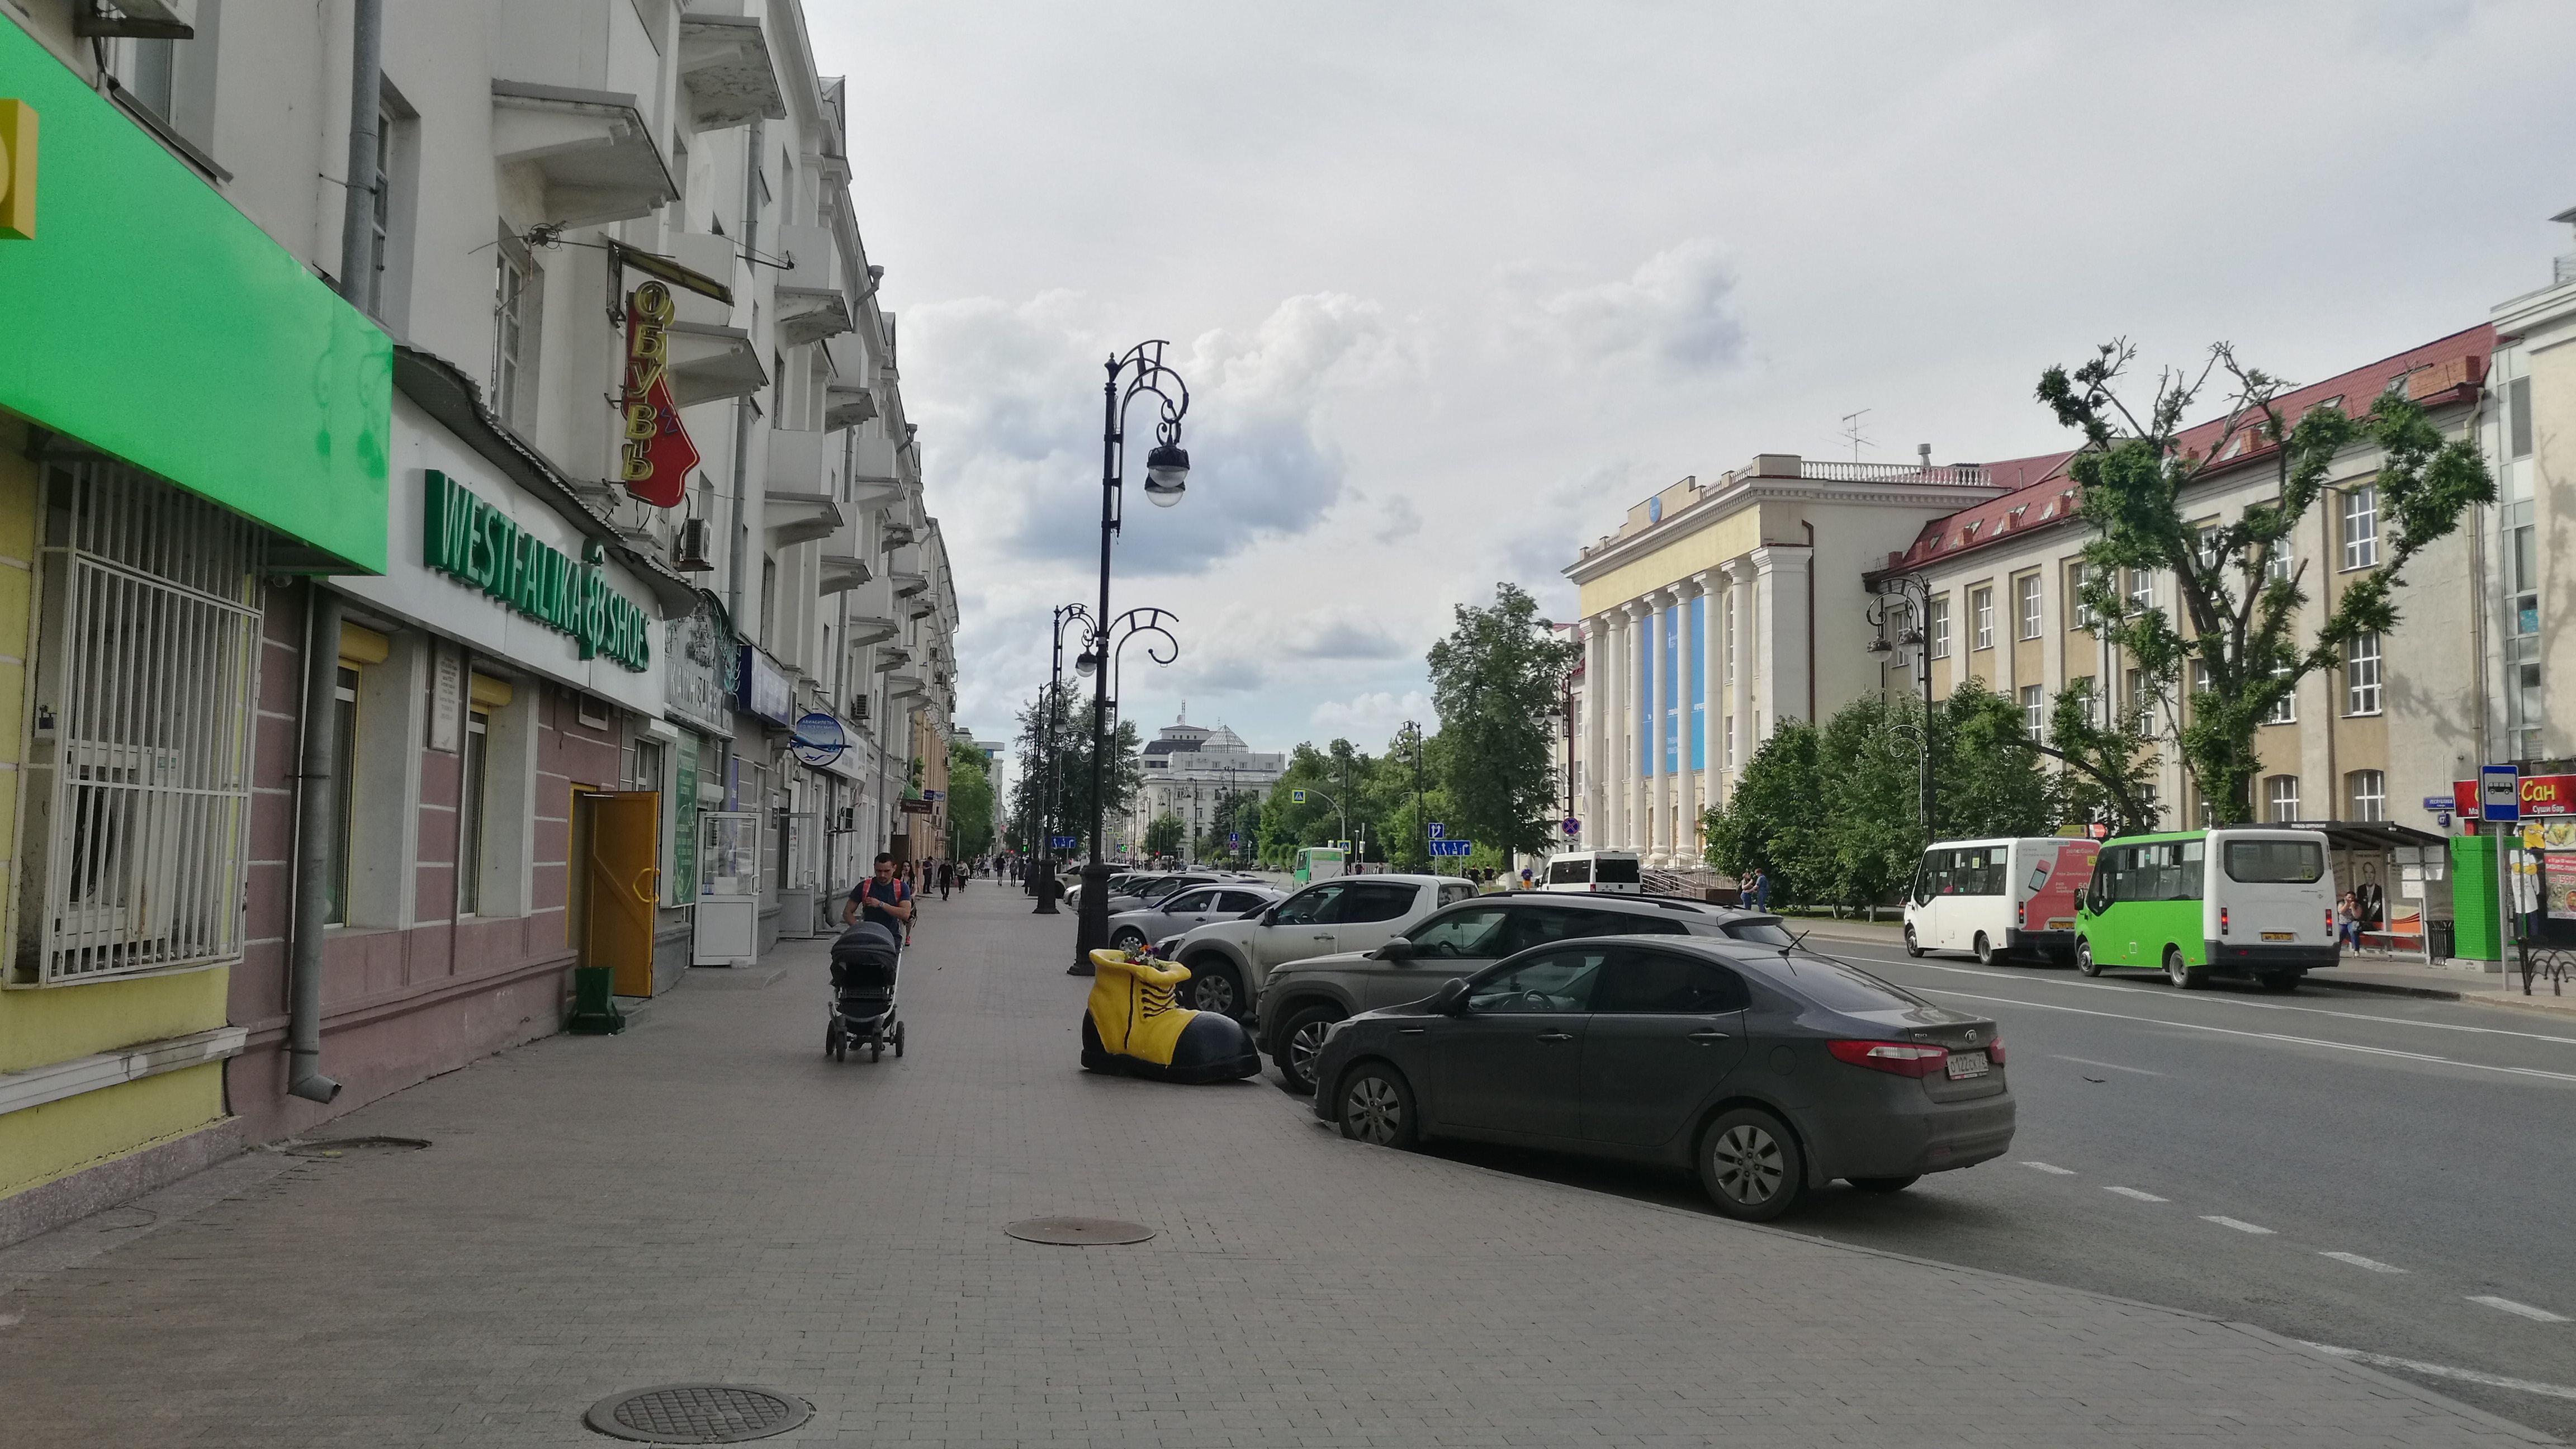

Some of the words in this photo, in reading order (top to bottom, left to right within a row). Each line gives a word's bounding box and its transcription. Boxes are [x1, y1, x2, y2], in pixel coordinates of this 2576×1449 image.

[621, 281, 671, 481] ОБУВЬ
[424, 469, 581, 637] WESTFALIKA
[605, 588, 651, 673] SHOES
[2532, 805, 2551, 815] Суши
[2552, 804, 2565, 813] бар
[2301, 867, 2313, 878] 12
